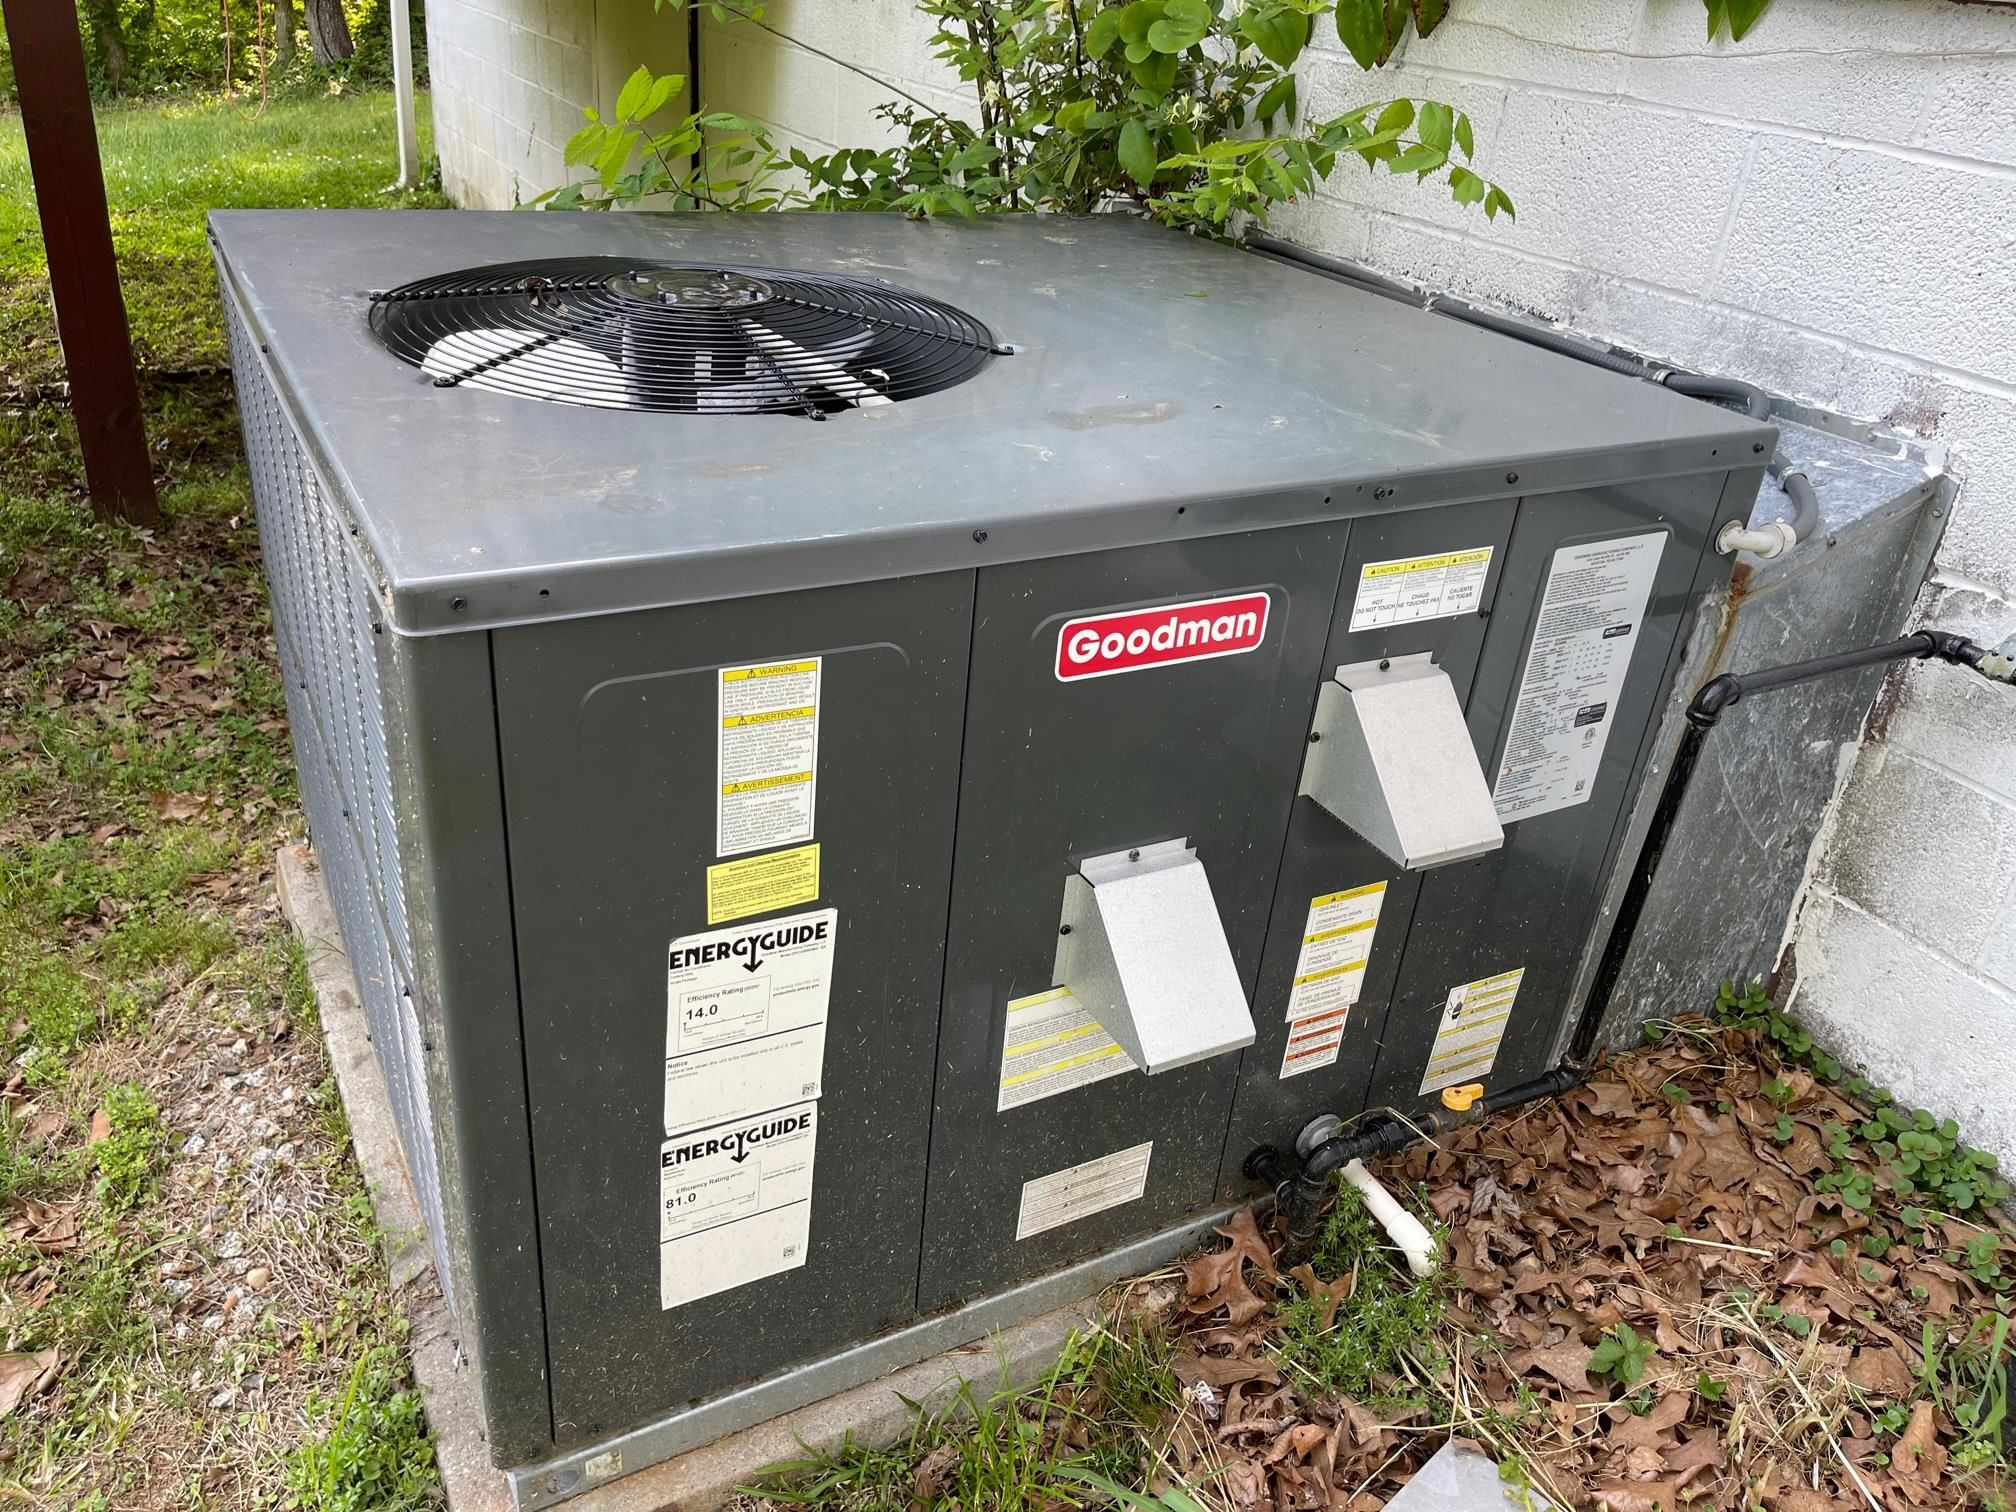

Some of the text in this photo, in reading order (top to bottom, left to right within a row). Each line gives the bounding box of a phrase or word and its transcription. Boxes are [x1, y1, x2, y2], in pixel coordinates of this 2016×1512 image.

[1418, 560, 1445, 568] ATTENTION
[1406, 599, 1428, 607] TOUCHEZ
[1068, 611, 1257, 664] Goodman
[759, 664, 797, 675] WARNING
[750, 709, 803, 722] ADVERTENCIA
[742, 774, 803, 789] AVERTISSEMENT
[670, 921, 828, 971] ENERGYGUIDE
[687, 991, 720, 1003] Efficiency
[722, 986, 744, 997] Rating
[686, 1004, 718, 1020] 14.0
[667, 1060, 688, 1070] Notice
[662, 1112, 811, 1168] ENERGYGUIDE
[676, 1182, 707, 1194] Efficiency
[709, 1174, 730, 1185] Rating
[666, 1193, 696, 1209] 81.0
